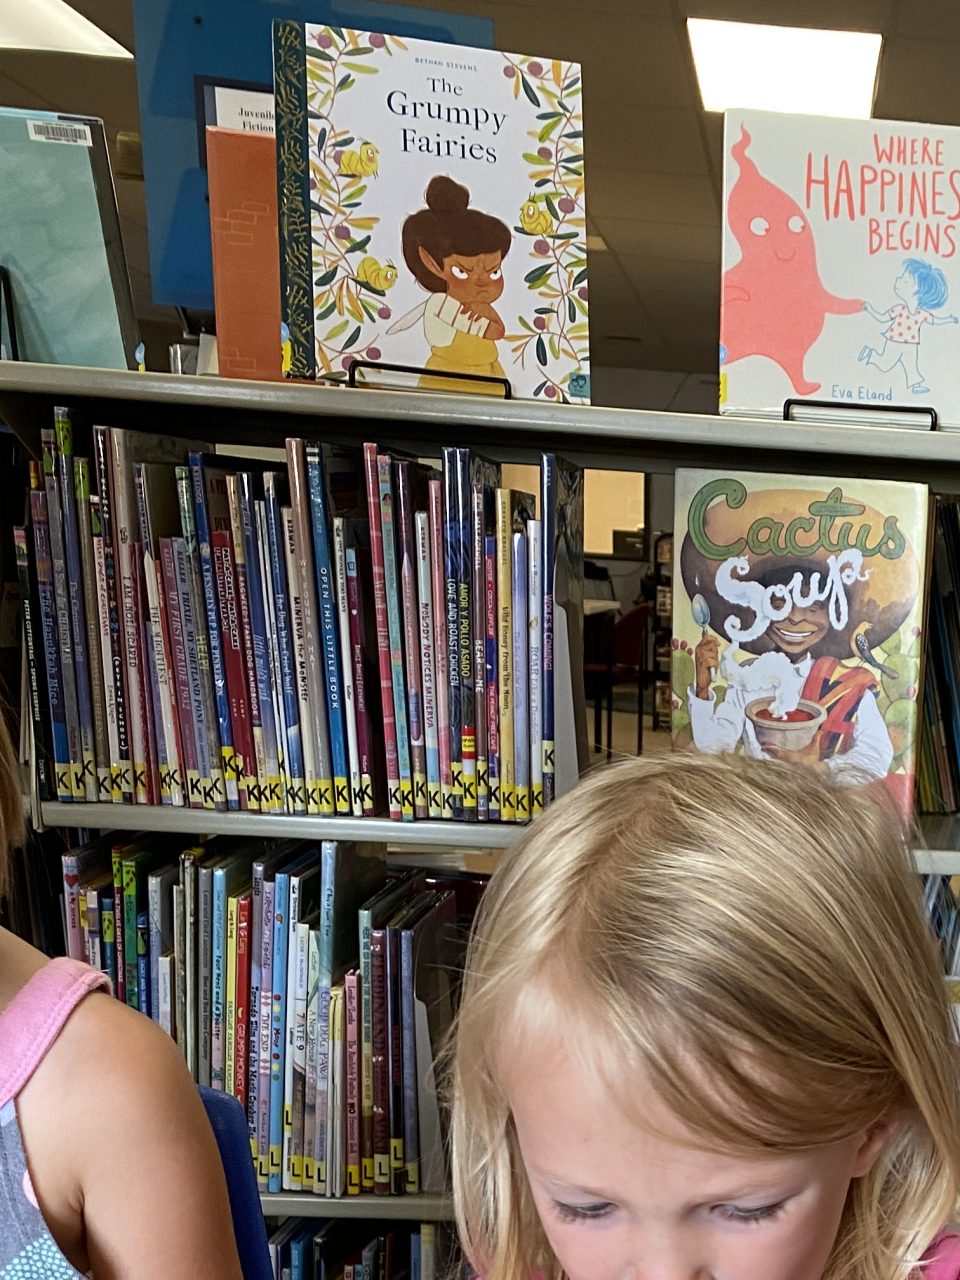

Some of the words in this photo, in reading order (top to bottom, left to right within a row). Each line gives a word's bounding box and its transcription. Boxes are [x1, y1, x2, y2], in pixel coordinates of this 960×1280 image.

[415, 57, 443, 66] BETHAN
[446, 61, 477, 72] STEVENS
[427, 76, 463, 96] The
[386, 90, 508, 135] Grumpy
[242, 120, 274, 132] Fiction
[401, 127, 497, 164] Fairies
[873, 133, 944, 166] WHERE
[868, 217, 956, 258] BEGINS
[832, 384, 853, 398] Eva
[858, 386, 892, 401] Eland
[687, 478, 906, 561] Cactus
[319, 567, 329, 598] OPEN
[447, 578, 456, 602] LOVE
[459, 583, 468, 607] AMOR
[715, 547, 873, 643] Soup
[323, 604, 332, 630] THIS
[448, 603, 457, 620] AND
[448, 623, 458, 651] ROAST
[460, 619, 469, 646] POLLO
[326, 635, 336, 671] LITTLE
[450, 654, 459, 686] CHICKEN
[461, 648, 470, 677] ASADO
[330, 677, 339, 709] BOOK
[223, 756, 236, 773] K
[58, 772, 70, 788] K
[100, 777, 110, 793] K
[121, 769, 130, 784] K
[169, 769, 180, 785] K
[452, 770, 463, 787] K
[203, 786, 214, 803] K
[258, 784, 270, 802] K
[307, 787, 318, 804] K
[336, 785, 348, 802] K
[389, 788, 400, 804] K
[416, 781, 426, 798] K
[261, 1013, 270, 1031] THE
[297, 1022, 305, 1041] ATE
[261, 1033, 270, 1052] END
[286, 1110, 293, 1126] L
[259, 1161, 269, 1176] L
[305, 1163, 314, 1179] L
[379, 1162, 388, 1176] L
[349, 1171, 359, 1187] L
